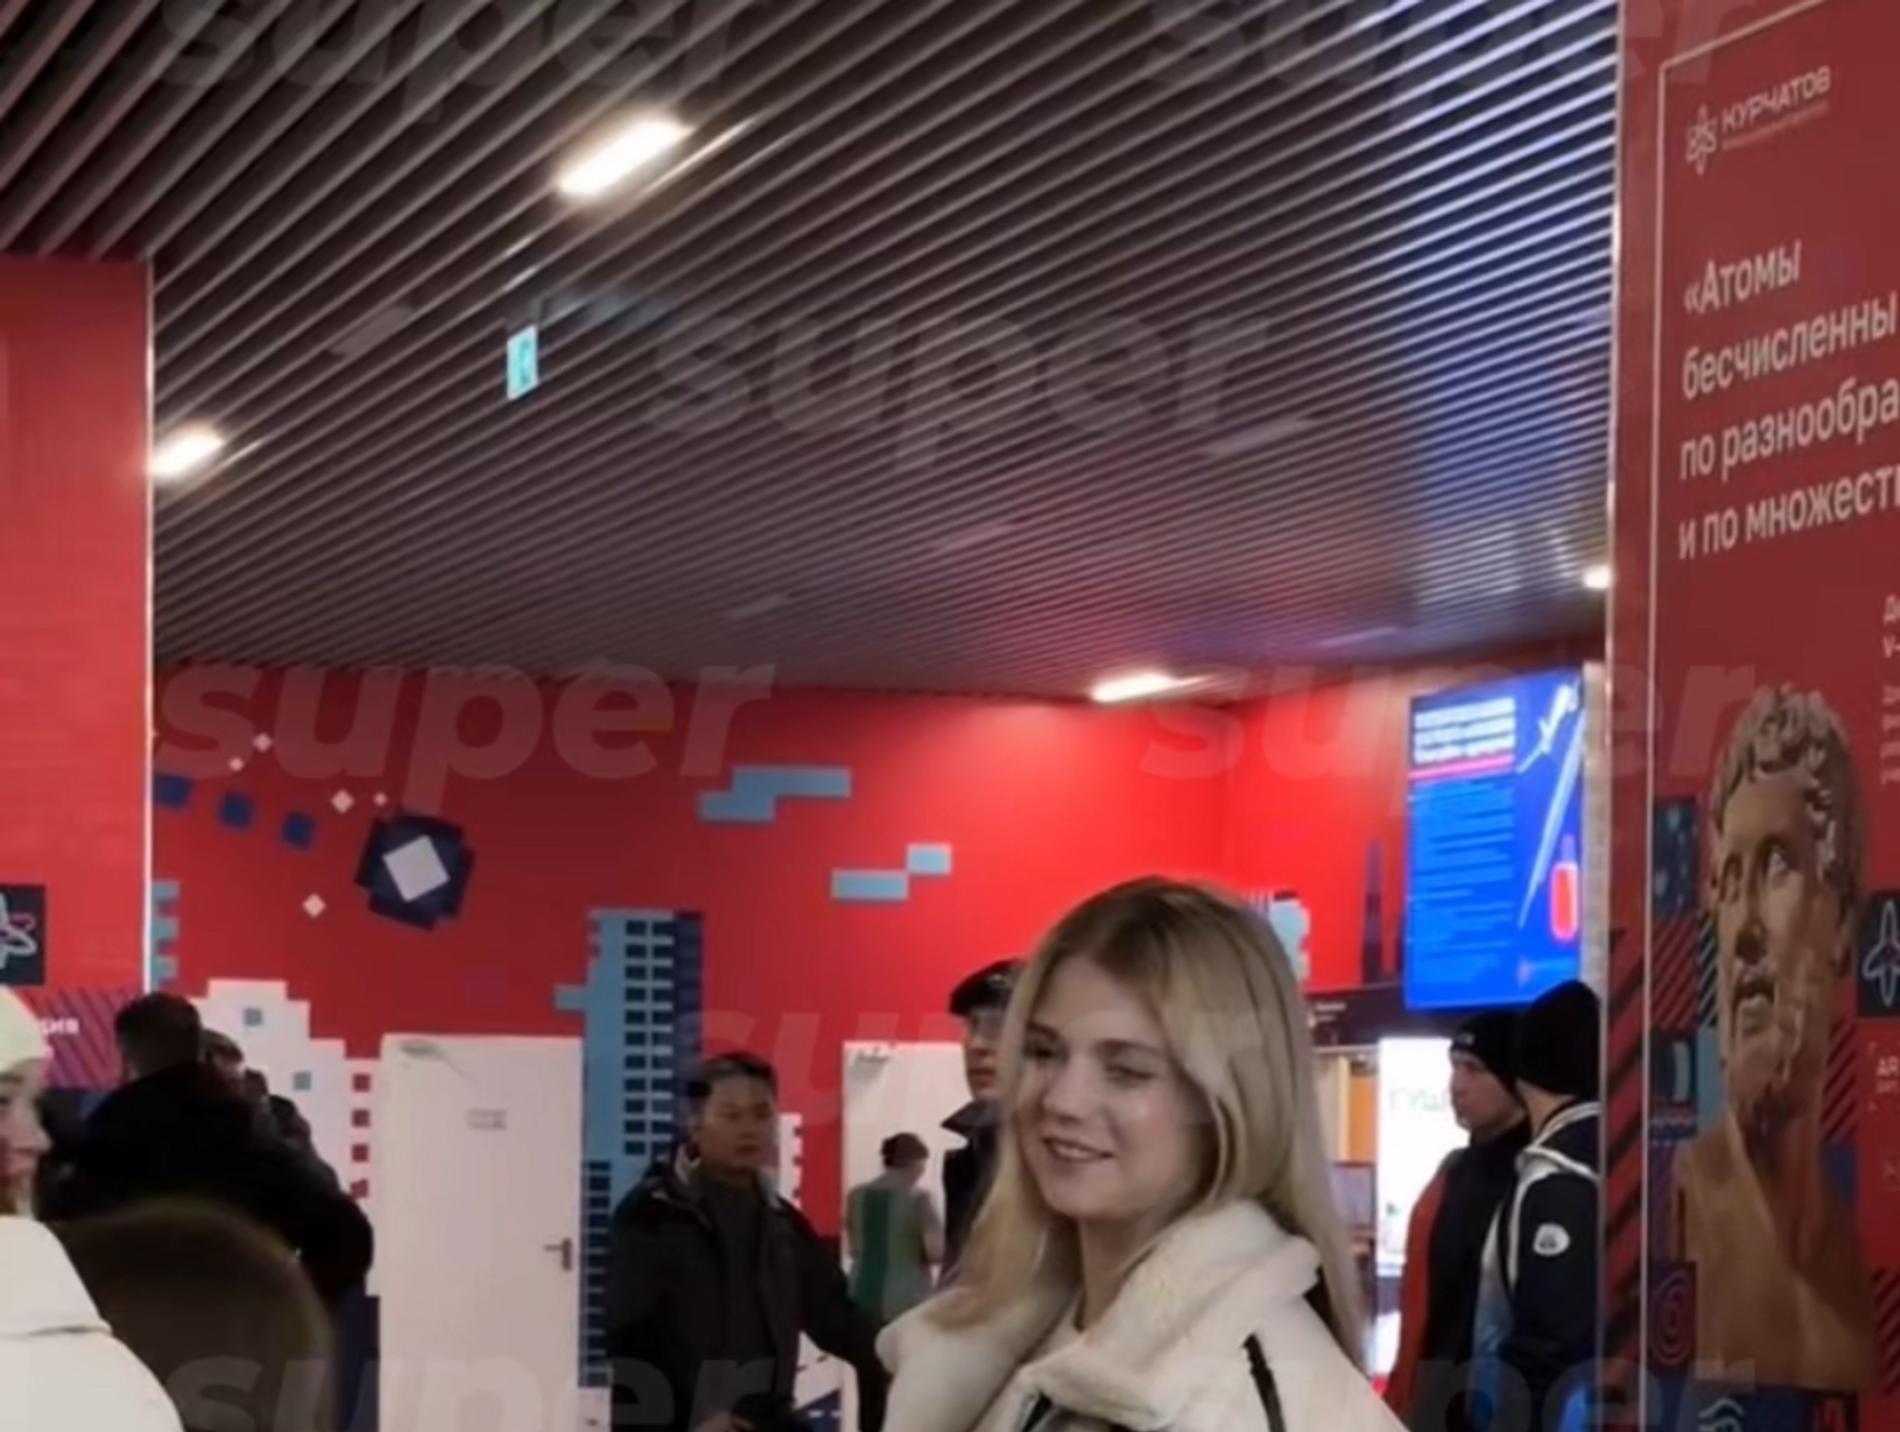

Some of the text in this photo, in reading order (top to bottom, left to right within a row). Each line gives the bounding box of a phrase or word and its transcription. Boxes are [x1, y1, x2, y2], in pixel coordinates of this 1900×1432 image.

[1721, 65, 1831, 135] КУРЧАТОВ
[1684, 240, 1802, 313] «Атомы
[1683, 291, 1898, 400] бесчисленны
[1680, 378, 1900, 483] по разнообра
[1679, 520, 1696, 560] и
[1704, 508, 1738, 555] по
